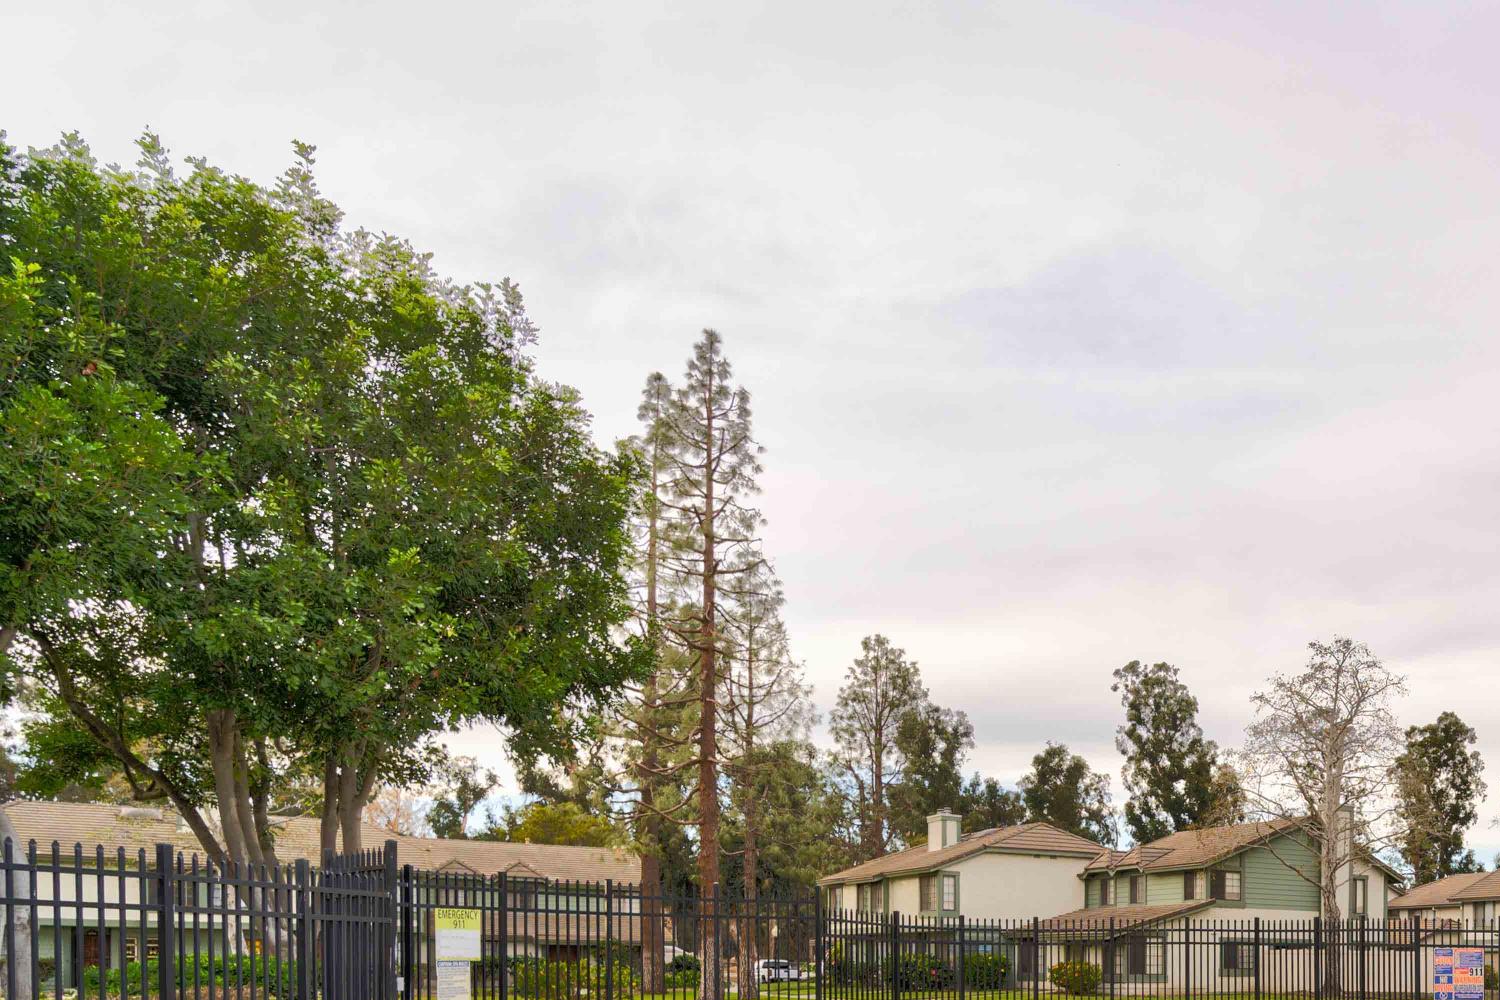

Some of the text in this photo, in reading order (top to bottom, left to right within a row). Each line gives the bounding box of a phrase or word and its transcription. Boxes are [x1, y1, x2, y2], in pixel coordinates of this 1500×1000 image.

[437, 909, 478, 920] EMERGENCY
[453, 920, 465, 929] 911
[1469, 967, 1483, 976] 911
